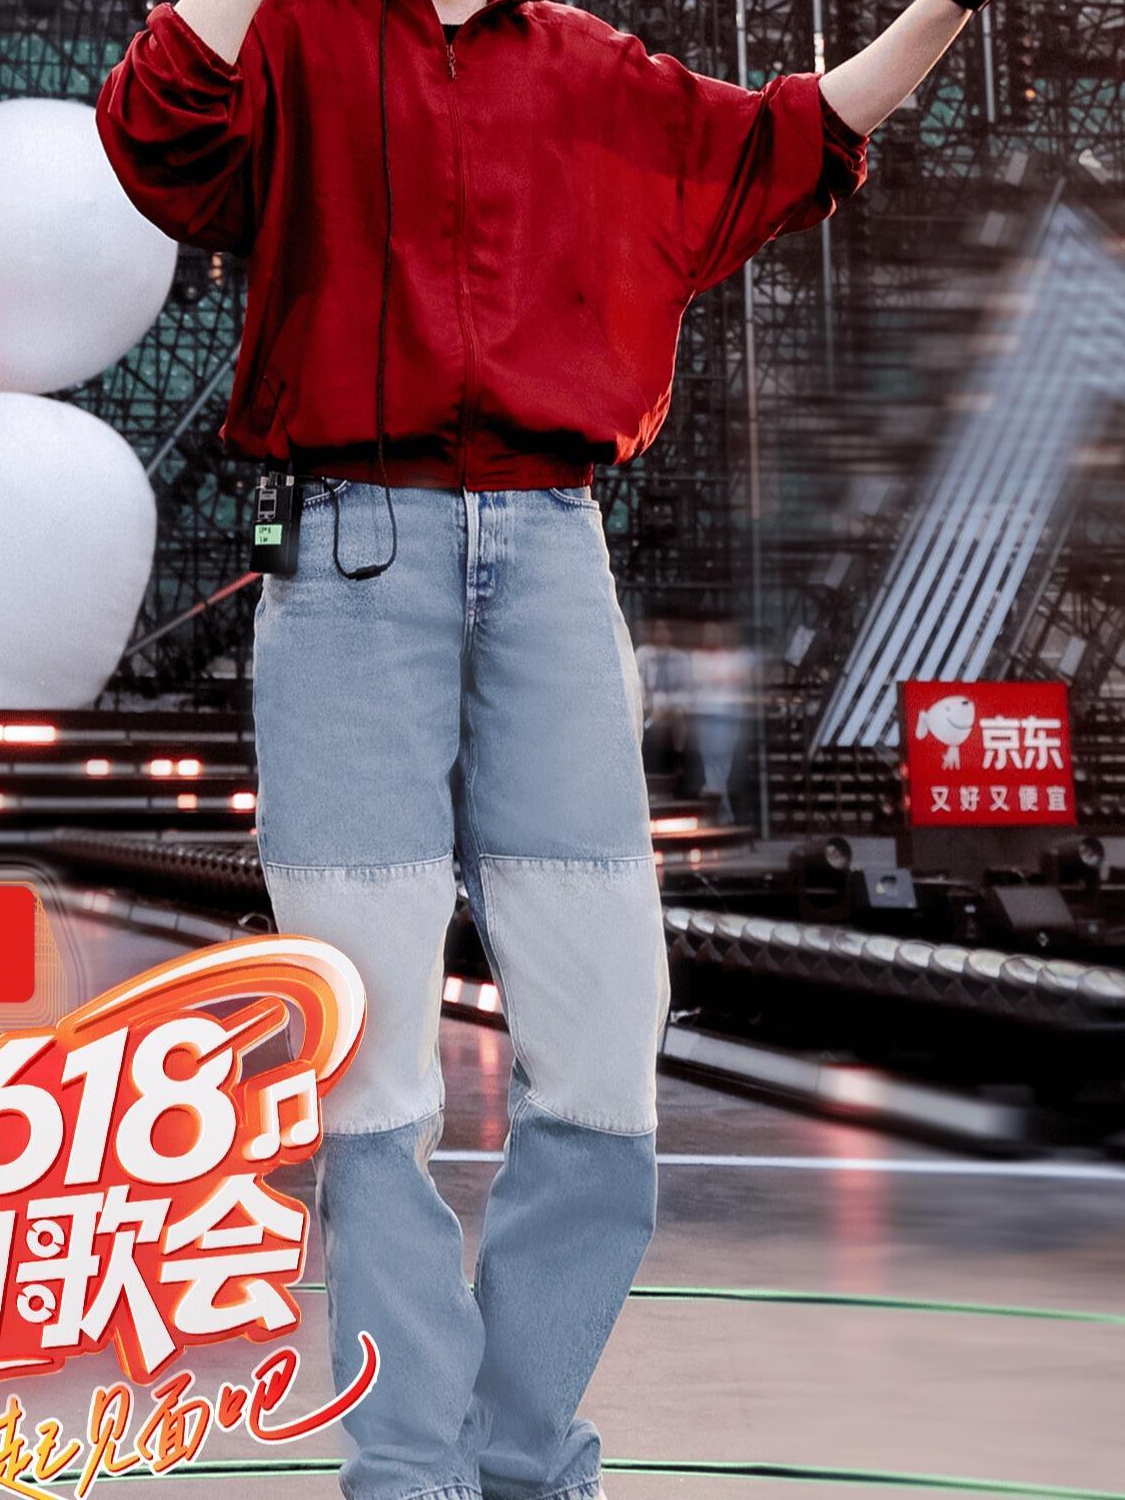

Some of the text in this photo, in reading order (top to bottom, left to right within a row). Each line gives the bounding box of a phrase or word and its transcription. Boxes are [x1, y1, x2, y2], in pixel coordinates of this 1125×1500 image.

[979, 715, 1064, 770] 京东
[930, 785, 1067, 813] 又好又便宜
